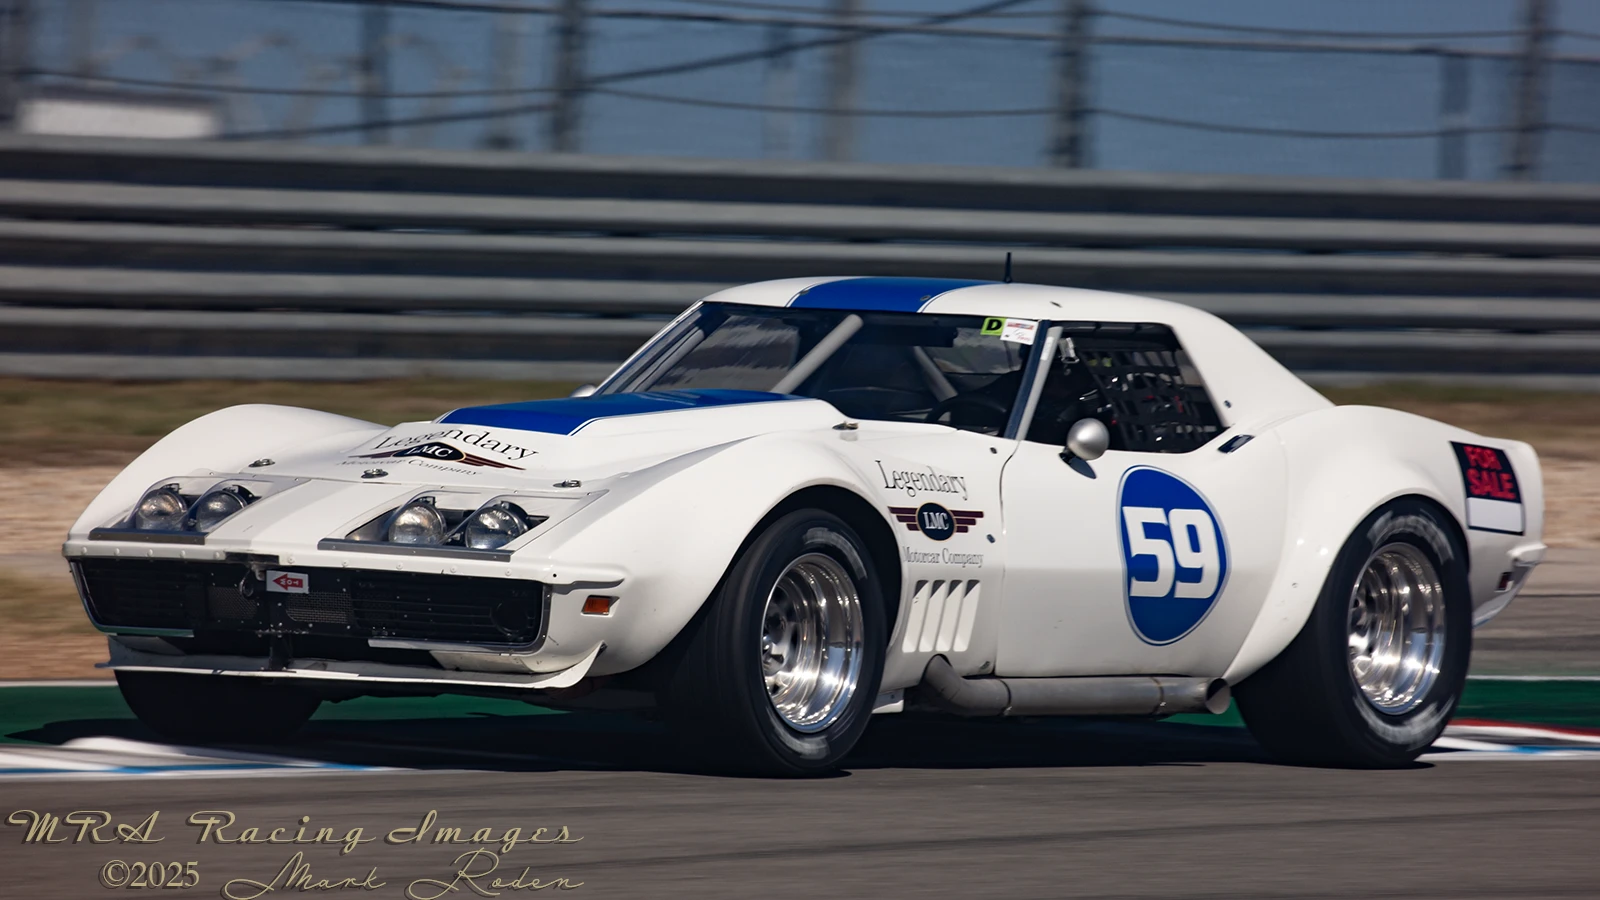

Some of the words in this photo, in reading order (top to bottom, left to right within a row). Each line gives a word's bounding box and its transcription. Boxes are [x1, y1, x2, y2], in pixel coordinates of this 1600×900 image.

[986, 319, 1003, 331] D
[373, 428, 540, 462] Legendary
[404, 444, 452, 458] LMC
[408, 458, 482, 476] Company
[1463, 445, 1503, 470] FOR
[875, 459, 968, 501] Legendary
[1467, 468, 1517, 500] SALE
[922, 511, 950, 530] LMC
[942, 547, 984, 568] Company
[1122, 506, 1221, 599] 59
[280, 578, 299, 586] TOW
